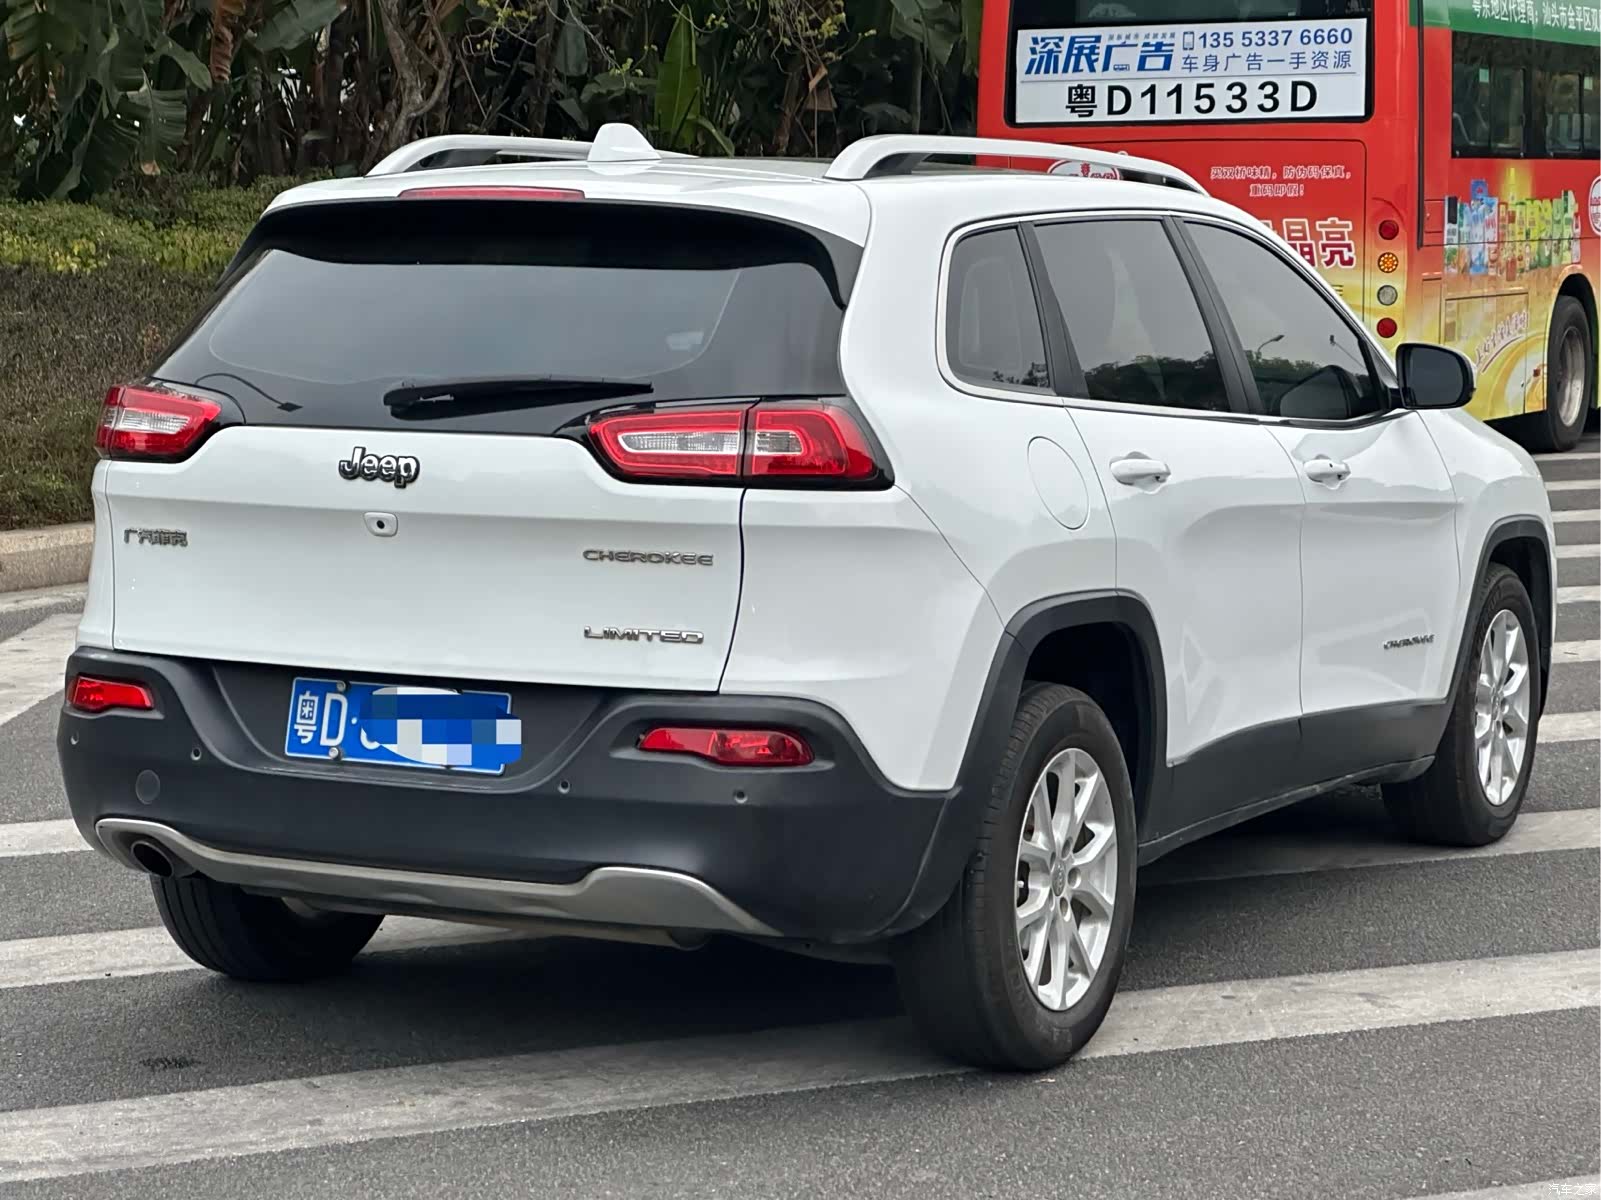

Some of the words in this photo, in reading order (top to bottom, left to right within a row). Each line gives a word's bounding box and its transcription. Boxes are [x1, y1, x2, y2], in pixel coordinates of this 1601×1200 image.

[1198, 31, 1234, 49] 135
[1241, 29, 1293, 48] 5337
[1299, 27, 1353, 46] 6660
[1024, 35, 1176, 75] 深展广告
[1181, 50, 1353, 73] 车身广告一手资源
[1065, 80, 1318, 118] 粤D11533D
[338, 446, 420, 489] Jeep
[582, 549, 714, 567] CHEROKEE
[583, 625, 705, 645] LIMITED
